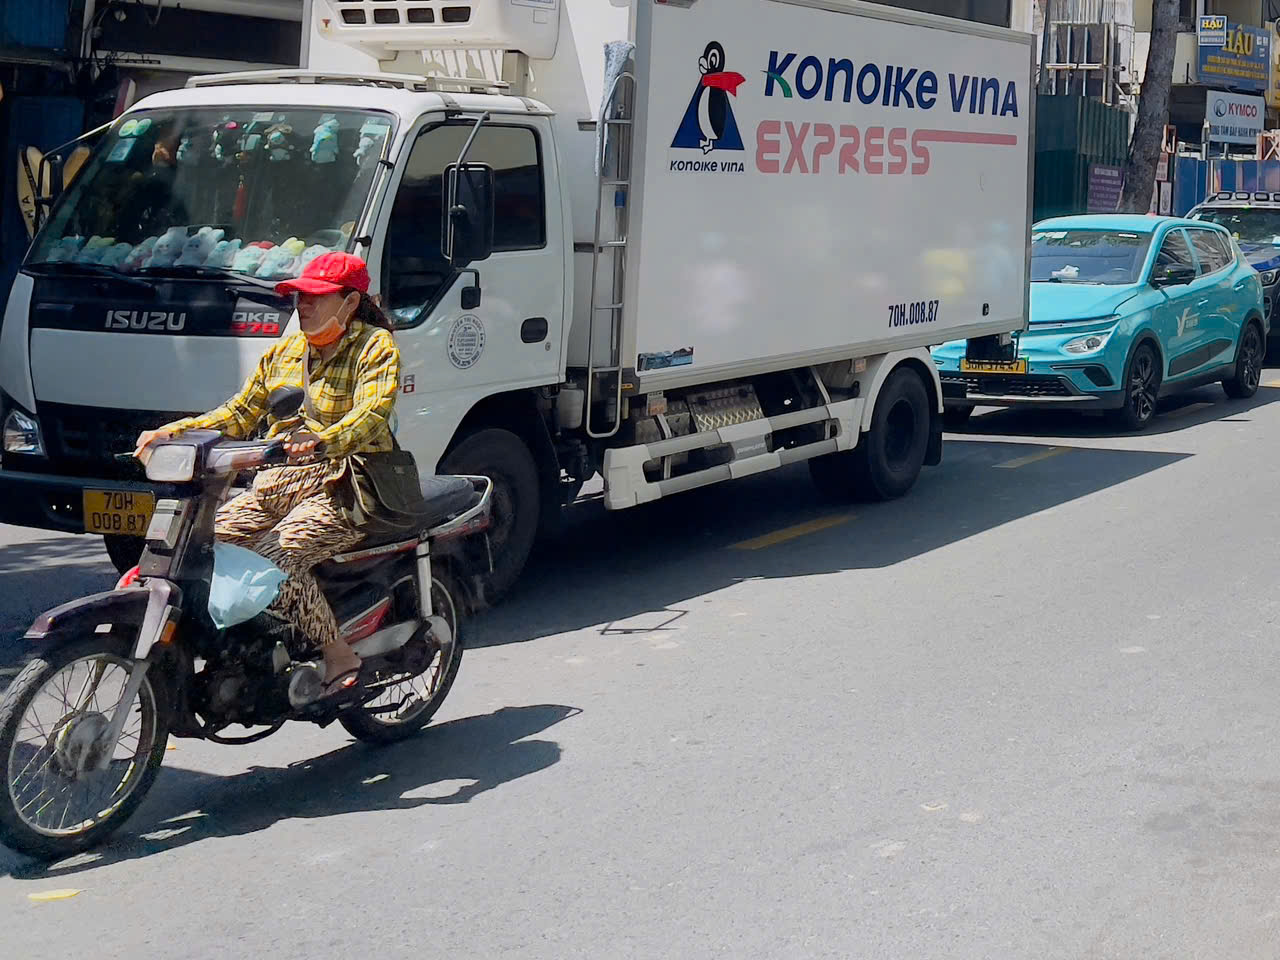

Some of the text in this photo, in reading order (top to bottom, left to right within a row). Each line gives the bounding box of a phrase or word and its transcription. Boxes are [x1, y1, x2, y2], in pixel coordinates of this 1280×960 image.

[1228, 103, 1257, 117] KYMCO
[755, 120, 931, 175] EXPRESS
[105, 310, 186, 331] ISUZU
[888, 300, 940, 328] 70H.008.87
[104, 491, 134, 511] 70H
